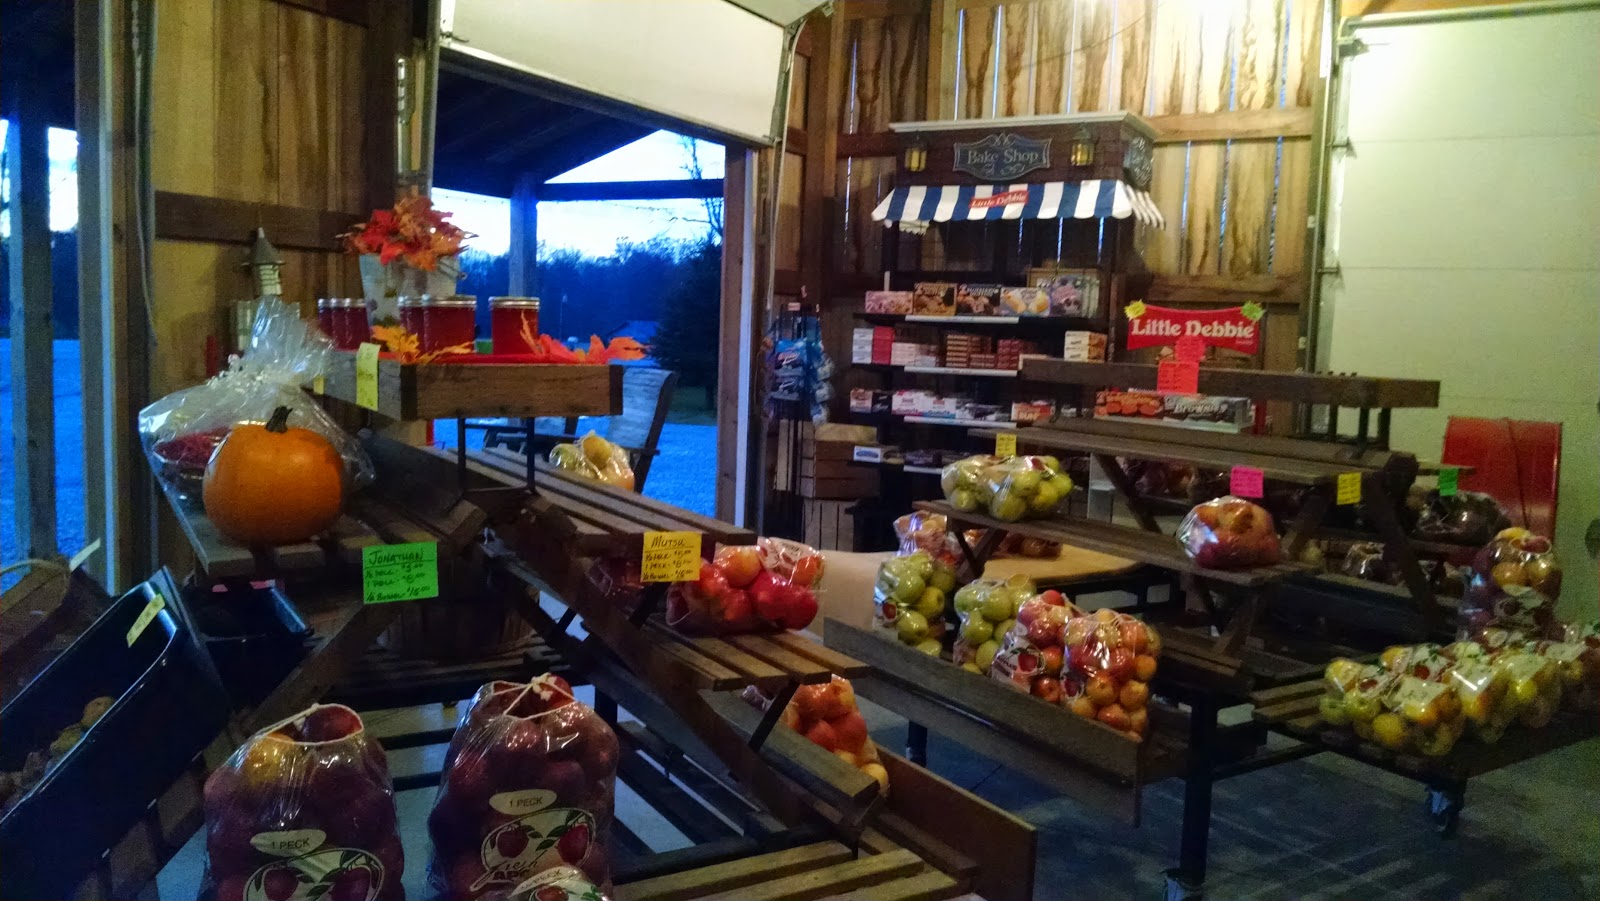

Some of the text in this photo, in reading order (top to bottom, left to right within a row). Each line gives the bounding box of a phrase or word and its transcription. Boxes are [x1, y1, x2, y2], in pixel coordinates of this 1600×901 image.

[967, 147, 1039, 165] Bake Shop
[1131, 318, 1256, 338] Little Debbie
[516, 796, 543, 807] PECK
[279, 838, 310, 850] PECK
